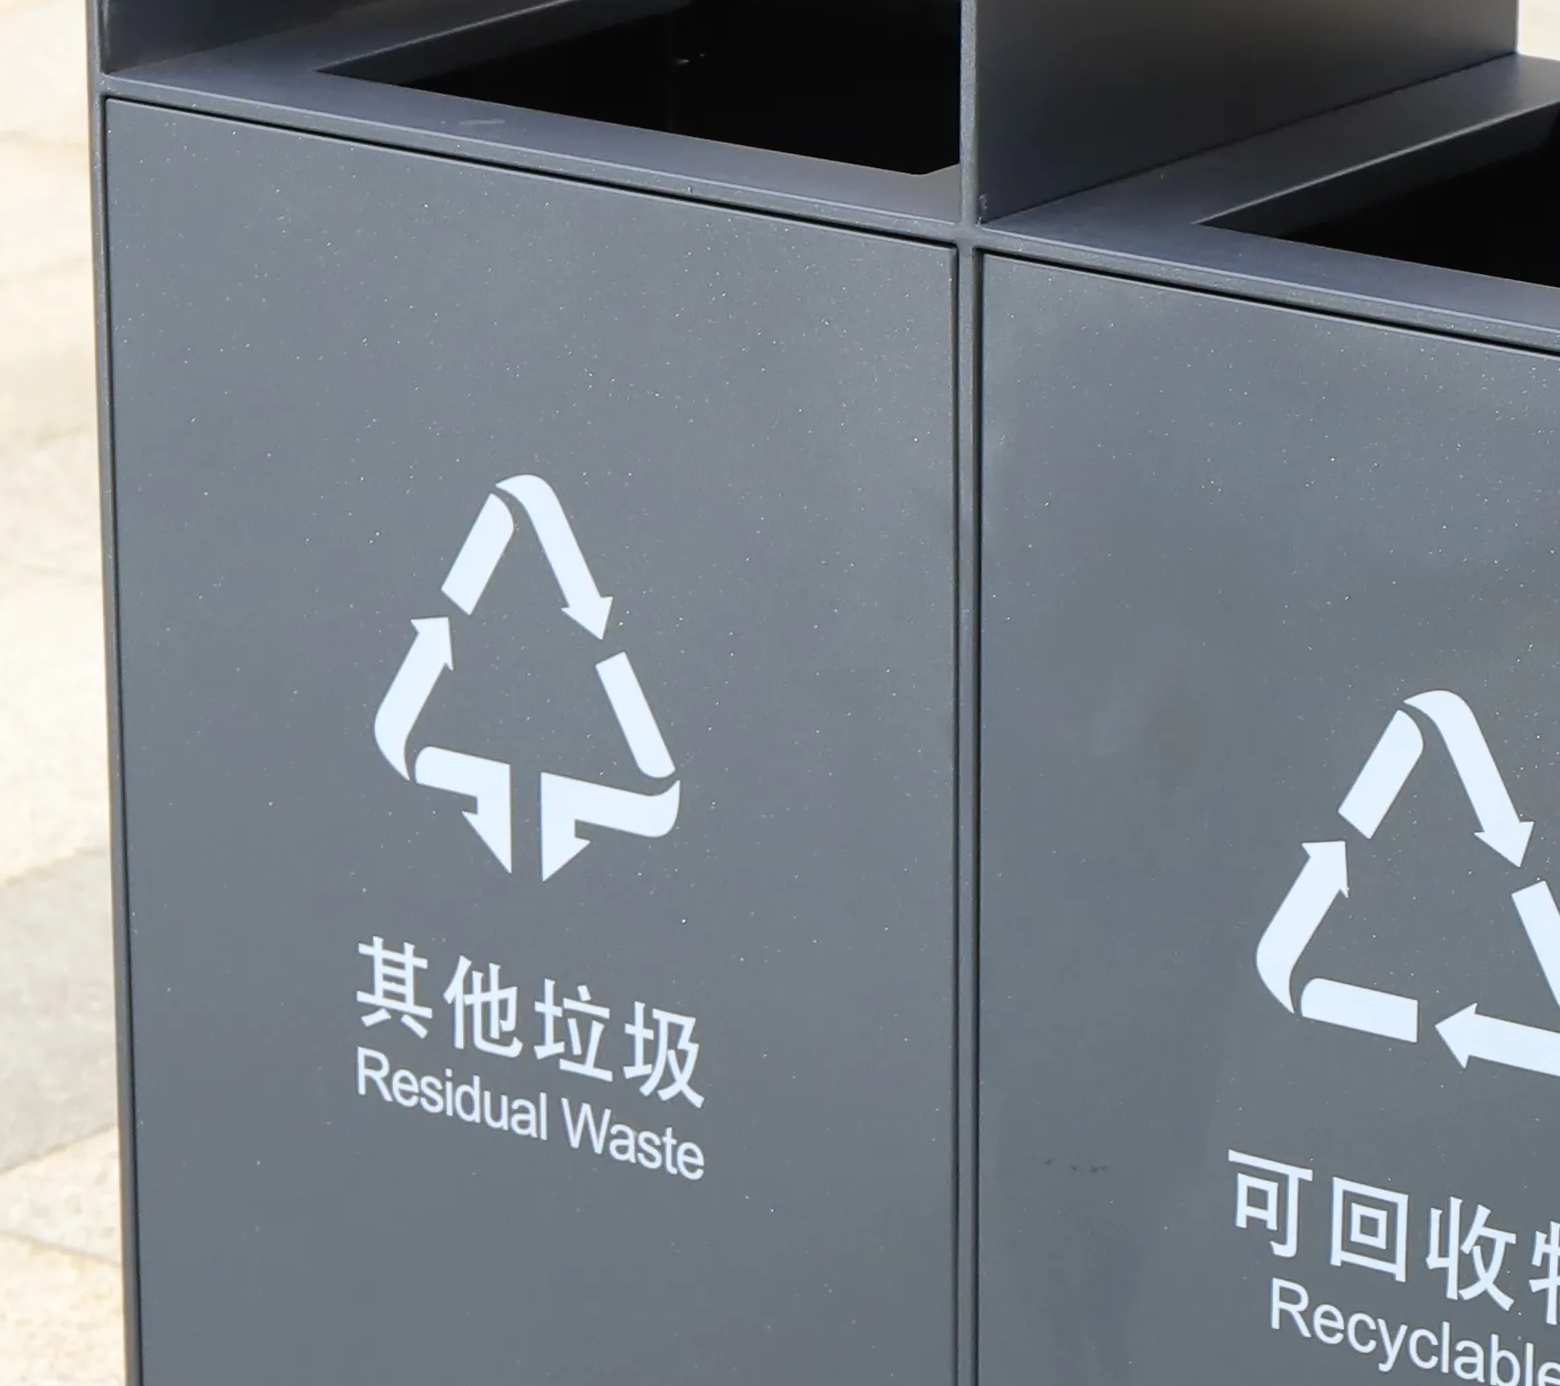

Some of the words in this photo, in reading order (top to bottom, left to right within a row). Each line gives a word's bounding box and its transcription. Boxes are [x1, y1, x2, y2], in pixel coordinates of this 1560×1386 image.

[356, 935, 705, 1109] 其他垃圾
[356, 1046, 548, 1141] Residual
[561, 1098, 706, 1181] Waste
